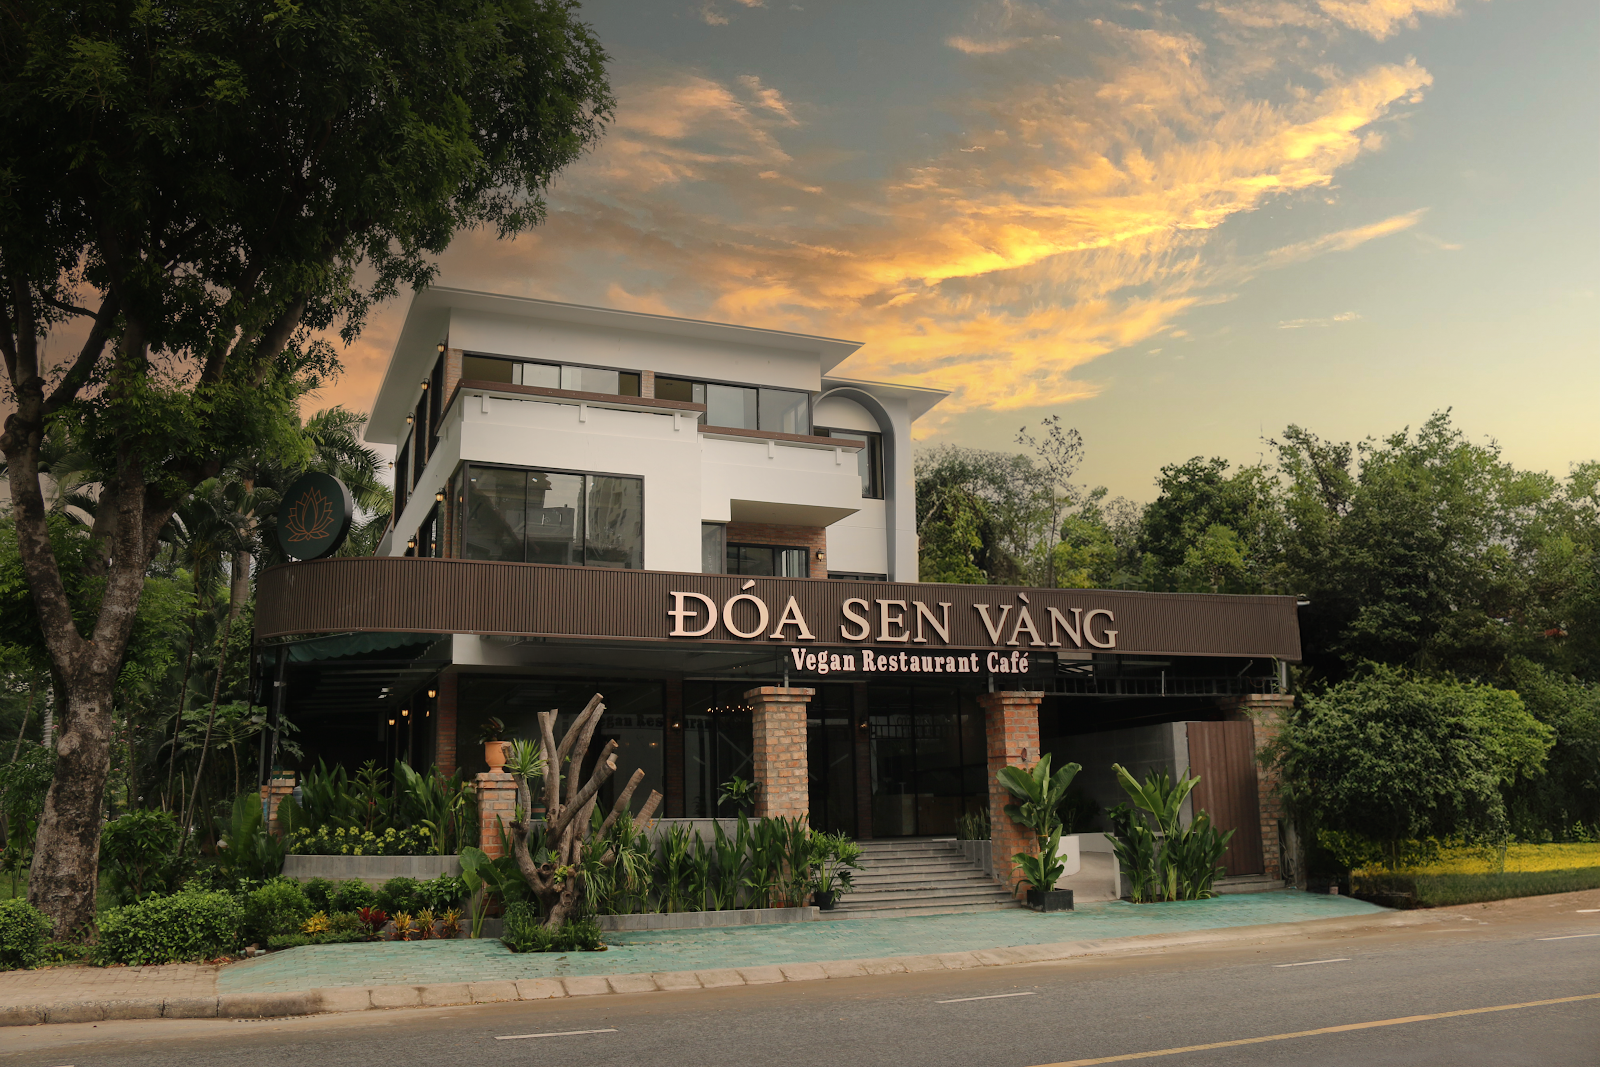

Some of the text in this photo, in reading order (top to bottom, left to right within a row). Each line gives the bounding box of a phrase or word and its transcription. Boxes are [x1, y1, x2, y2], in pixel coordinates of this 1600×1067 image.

[667, 579, 1119, 649] ĐÓA SEN VÀNG
[791, 647, 1030, 674] Vegan Restaurant Café
